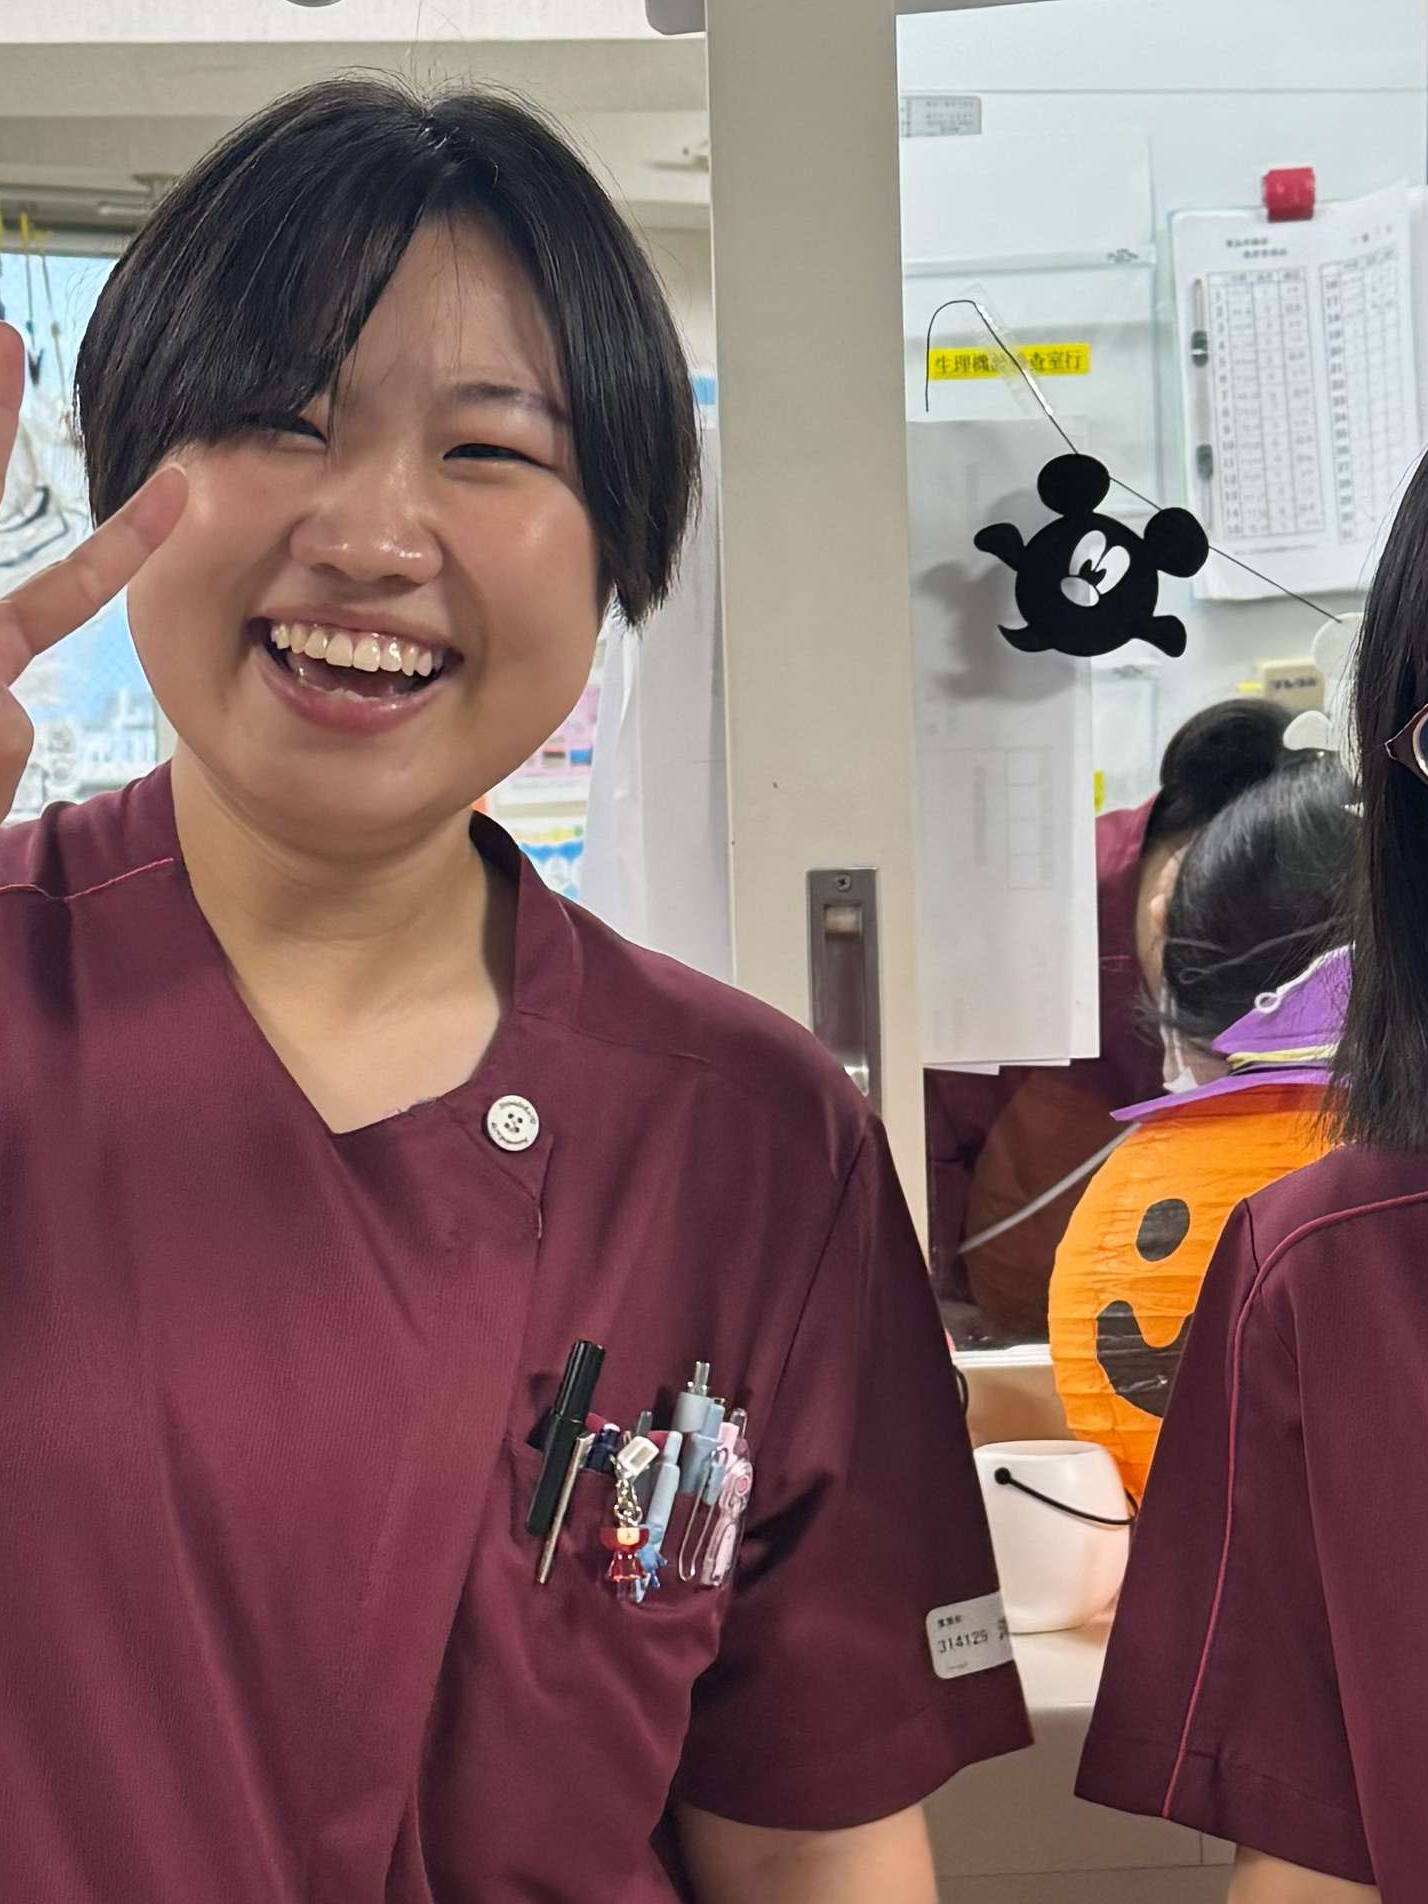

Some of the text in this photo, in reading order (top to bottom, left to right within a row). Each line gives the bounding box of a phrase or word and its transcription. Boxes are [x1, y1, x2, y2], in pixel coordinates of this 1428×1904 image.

[934, 350, 1083, 375] 生理機査室行
